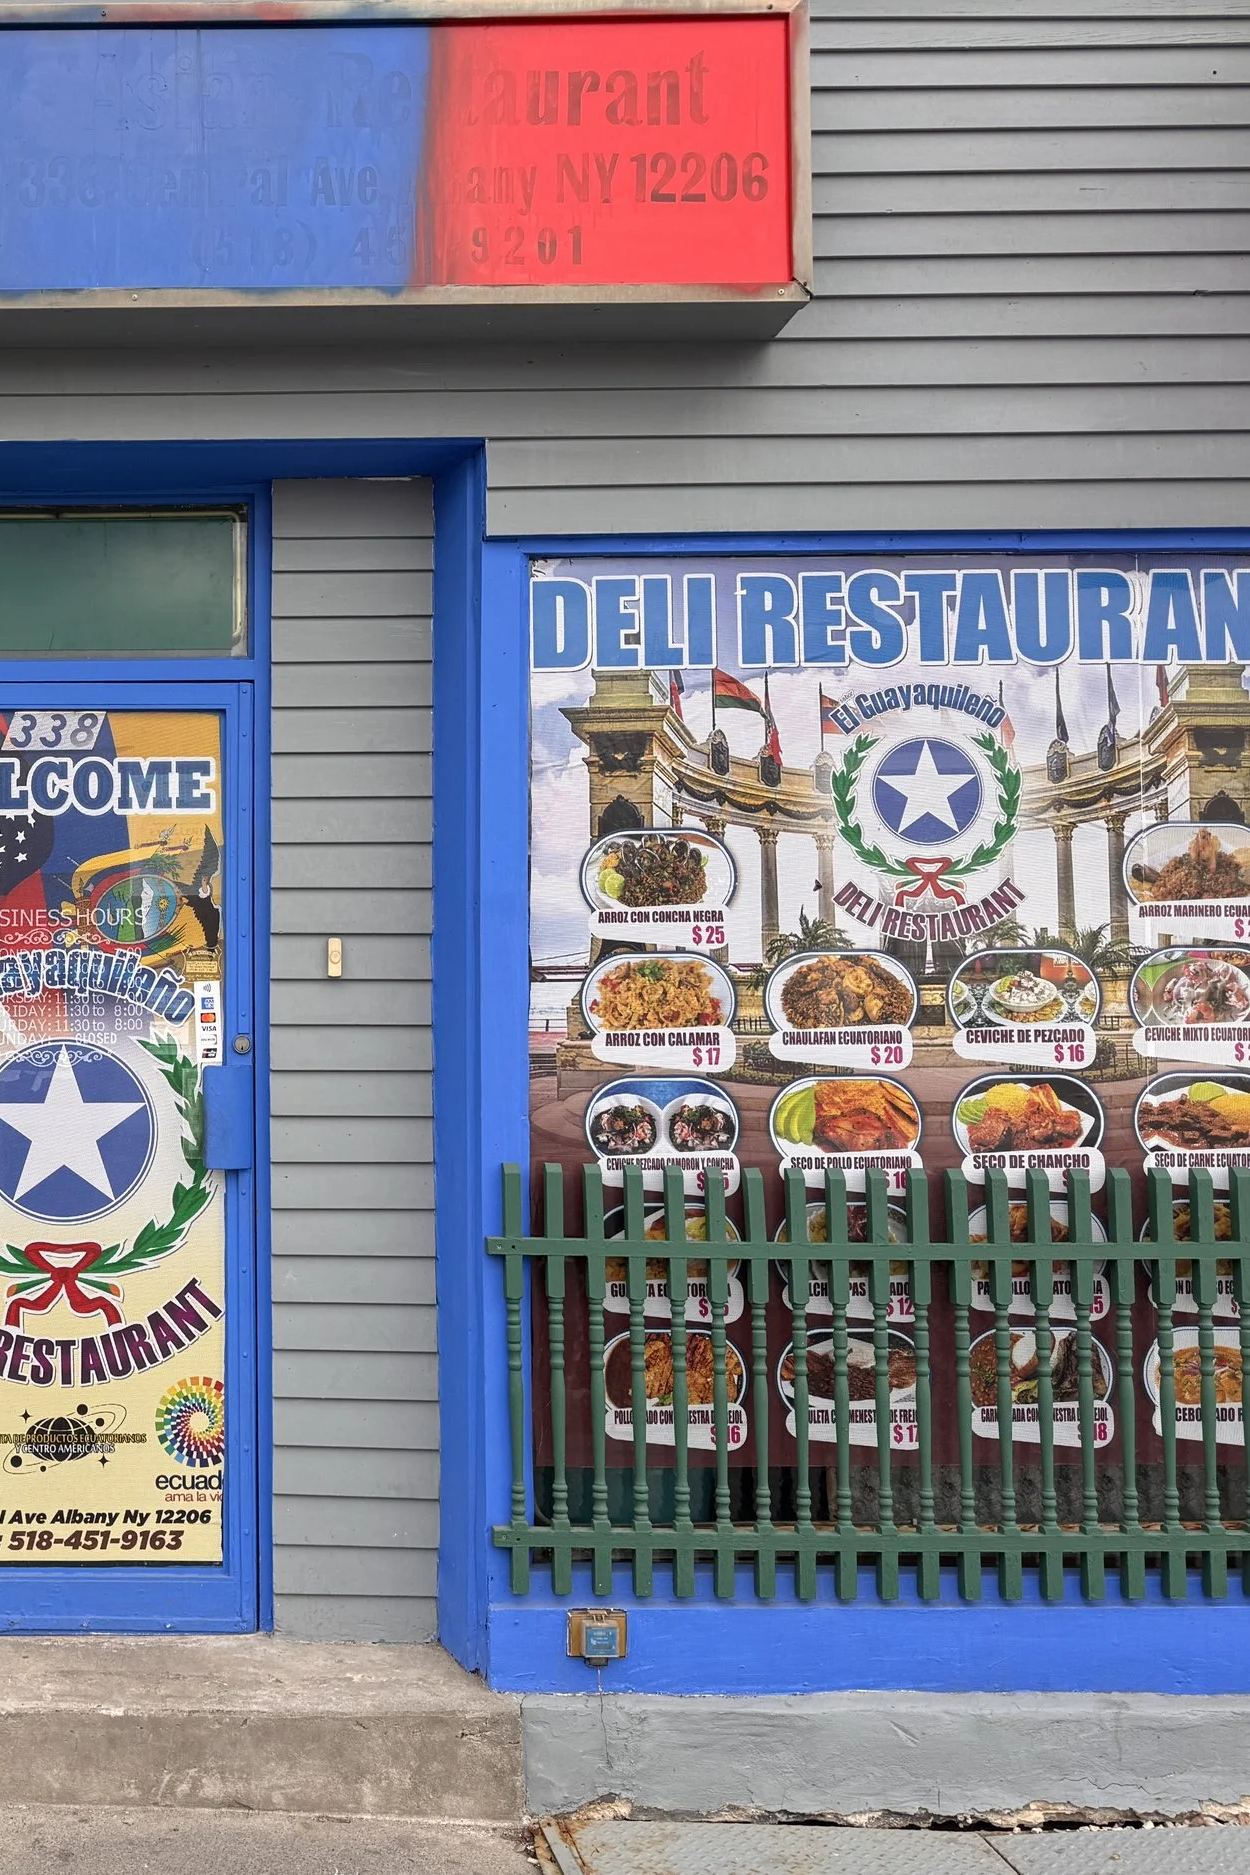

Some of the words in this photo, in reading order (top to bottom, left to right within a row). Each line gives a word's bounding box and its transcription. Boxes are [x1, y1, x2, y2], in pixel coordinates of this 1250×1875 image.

[556, 152, 622, 204] NY
[630, 151, 770, 204] 12206
[533, 578, 714, 668] DELI
[829, 703, 861, 735] El
[855, 683, 1006, 729] Guayaquileño
[9, 713, 98, 748] 338
[77, 908, 147, 926] HOURS
[598, 911, 628, 923] ARROZ
[630, 911, 650, 923] CON
[652, 911, 691, 923] CONCHA
[693, 910, 724, 923] NEGRA
[833, 880, 884, 928] DELI
[881, 876, 1027, 942] RESTAURANT
[1174, 905, 1222, 917] MARINERO
[705, 926, 725, 944] 25
[605, 1033, 640, 1046] ARROZ
[642, 1032, 666, 1046] CON
[668, 1032, 720, 1046] CALAMAR
[782, 1032, 836, 1045] CHAULAFAN
[838, 1031, 902, 1045] ECUATORIANO
[966, 1030, 1015, 1044] CEVICHE
[1017, 1030, 1032, 1043] DE
[1034, 1029, 1085, 1043] PEZCADO
[1145, 1027, 1181, 1041] CEVICHE
[1183, 1027, 1209, 1041] MIXTO
[705, 1048, 720, 1065] 17
[884, 1046, 903, 1064] 20
[1067, 1045, 1084, 1062] 16
[791, 1157, 812, 1169] SECO
[815, 1157, 825, 1169] DE
[827, 1156, 852, 1169] POLLO
[854, 1156, 912, 1169] ECUATORIANO
[973, 1155, 1006, 1169] SECO
[1010, 1155, 1025, 1169] DE
[1028, 1154, 1090, 1168] CHANCHO
[1155, 1153, 1175, 1167] SECO
[1177, 1153, 1187, 1167] DE
[1189, 1153, 1215, 1167] CARNE
[26, 1434, 78, 1444] PRODUCTOS
[155, 1470, 223, 1490] ecuad
[165, 1492, 193, 1501] ama
[196, 1491, 206, 1501] la
[9, 1510, 47, 1525] Ave
[51, 1509, 119, 1526] Albany
[123, 1510, 149, 1526] Ny
[155, 1509, 211, 1524] 12206
[7, 1530, 184, 1551] 518-451-9163
